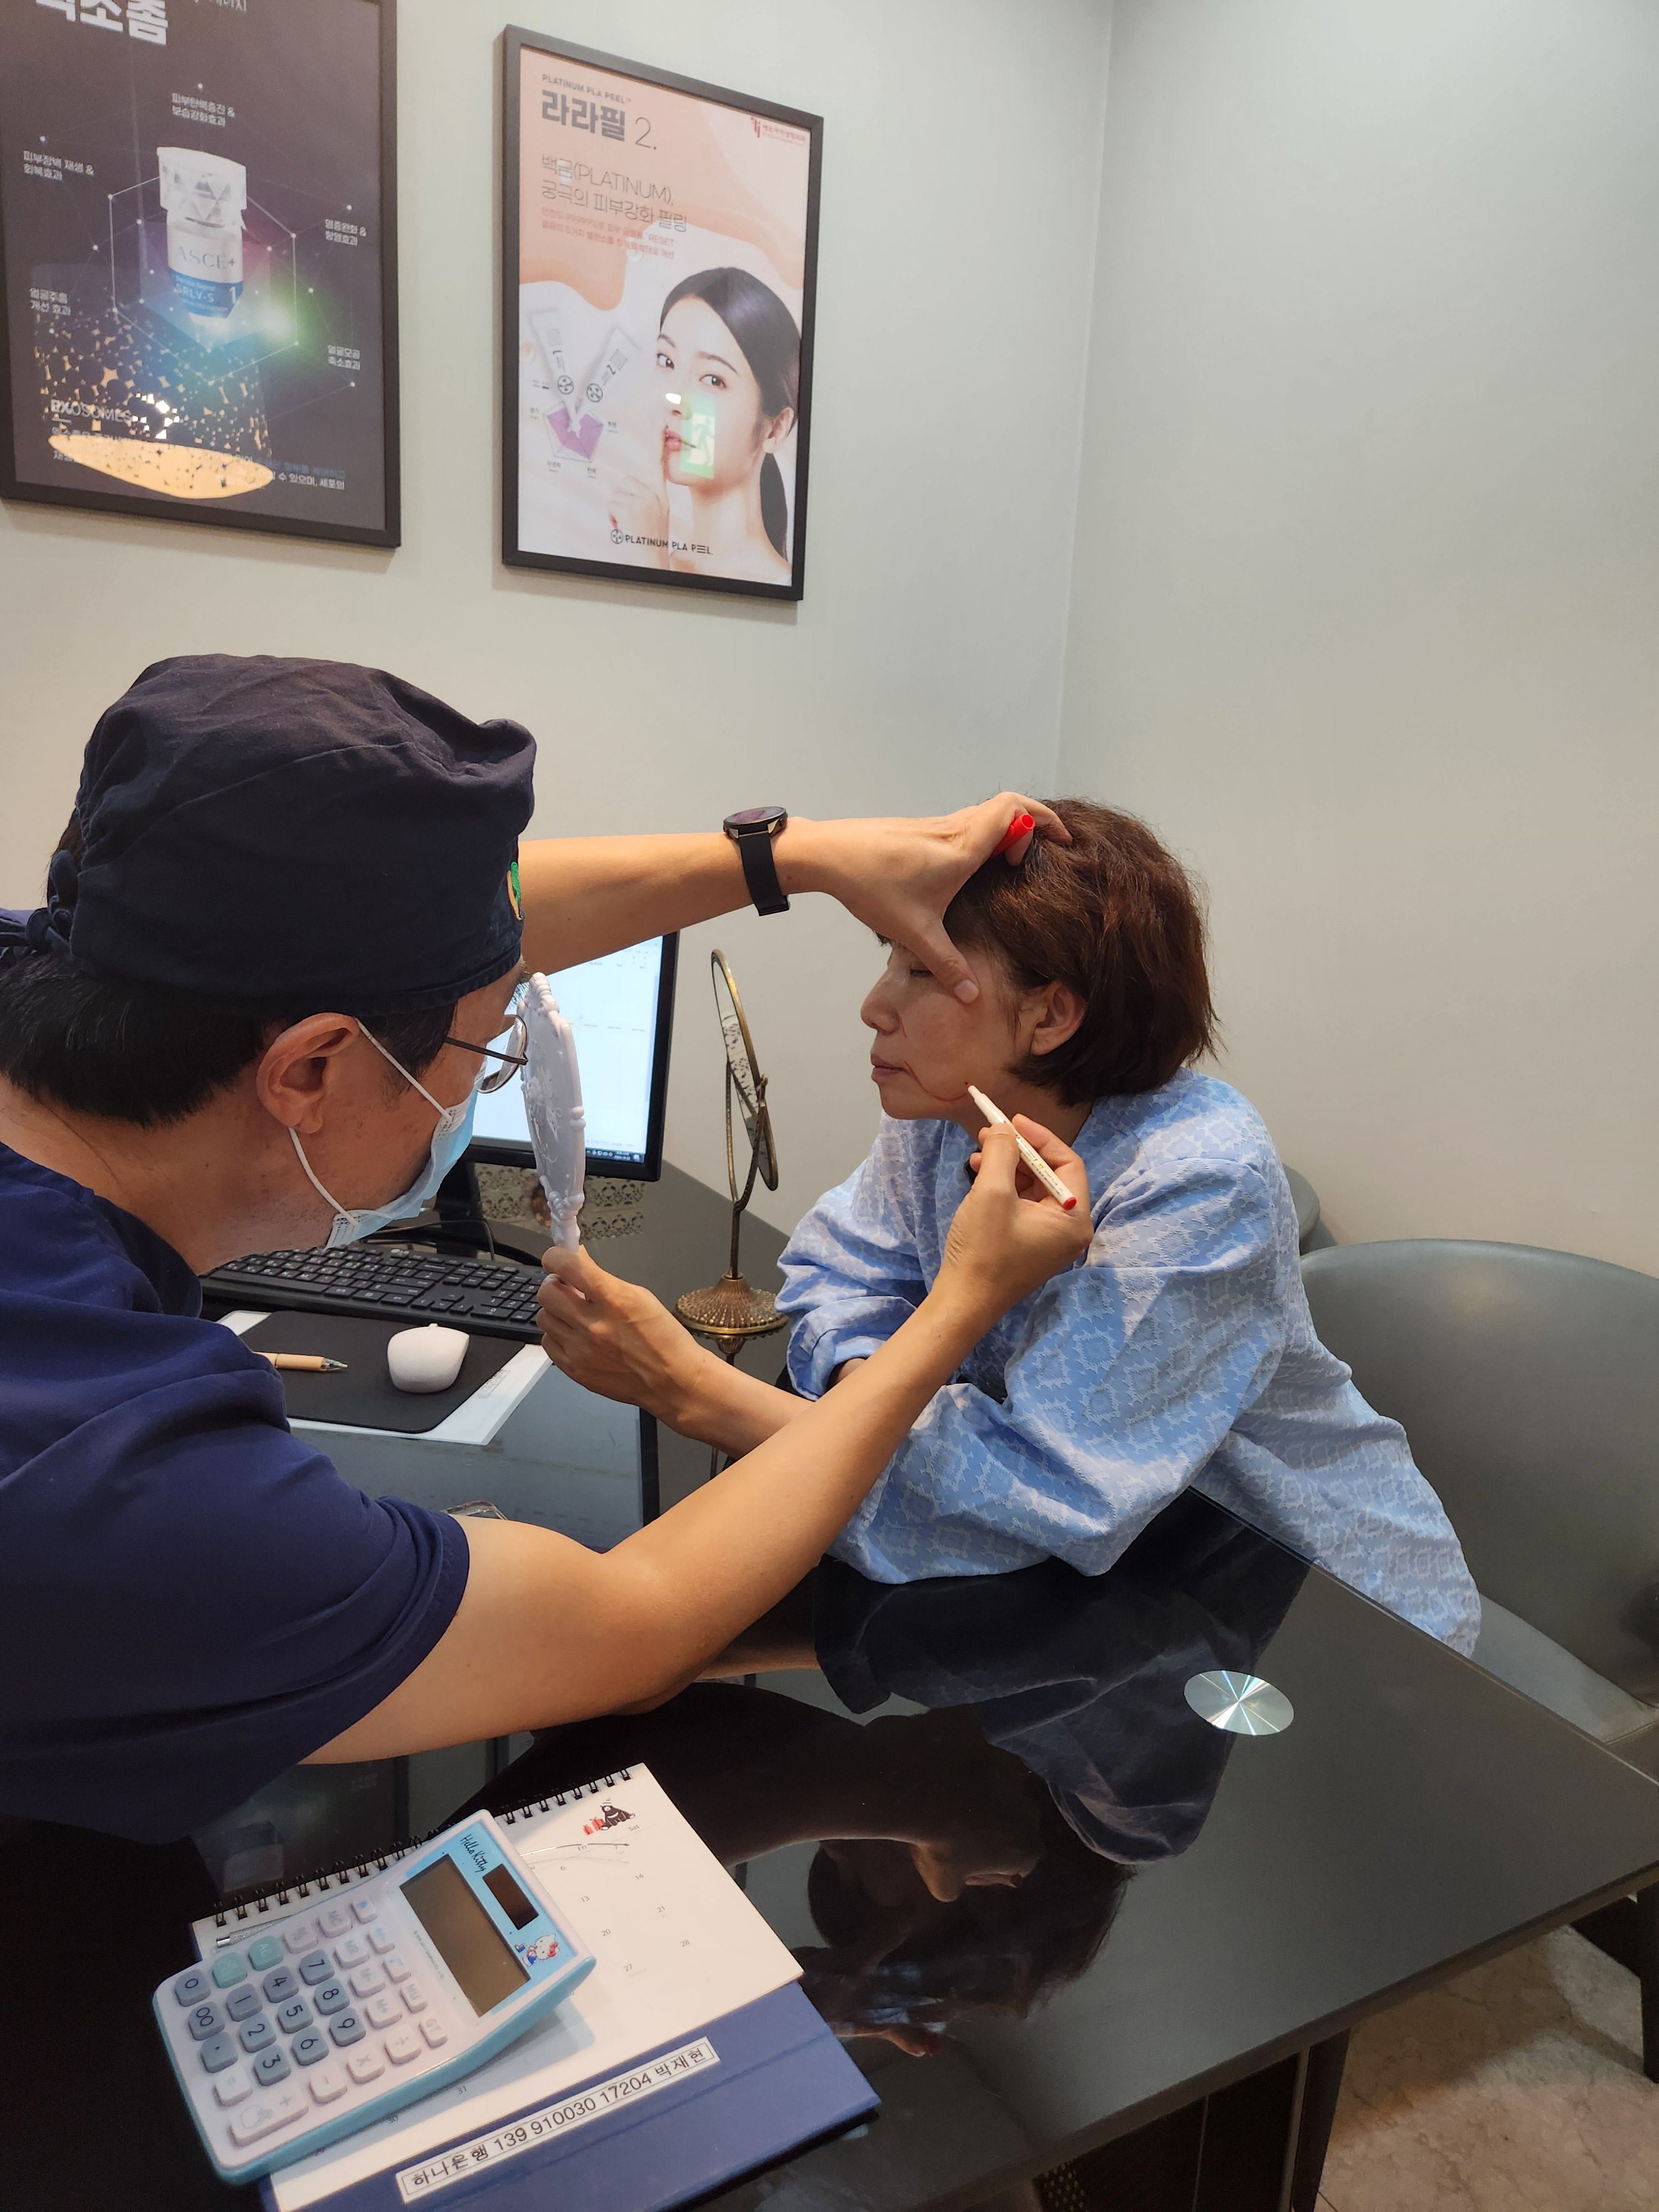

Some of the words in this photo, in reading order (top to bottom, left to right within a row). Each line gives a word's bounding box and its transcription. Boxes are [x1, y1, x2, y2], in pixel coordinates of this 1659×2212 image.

[542, 74, 584, 92] PLATINUM
[587, 86, 602, 97] PLA
[542, 90, 625, 142] 라라필
[541, 179, 588, 208] 궁극의
[594, 193, 654, 224] 피부강화
[659, 210, 687, 233] 필링
[625, 535, 669, 549] PLATINUM
[672, 541, 687, 551] PLA
[628, 1824, 640, 1832] Sat
[460, 1834, 479, 1854] Hello
[471, 1850, 488, 1873] Kitty
[680, 1939, 690, 1947] 28
[257, 1943, 272, 1957] AC
[308, 1959, 325, 1967] 7
[185, 1978, 199, 1989] 0
[273, 1977, 288, 1987] 4
[235, 1995, 252, 2004] 1
[322, 1987, 340, 2000] 8
[196, 2007, 214, 2027] 00
[286, 2004, 304, 2017] 5
[248, 2023, 265, 2037] 2
[337, 2018, 355, 2029] 9
[300, 2038, 319, 2049] 6
[263, 2054, 281, 2069] 3
[457, 2085, 467, 2095] 31
[494, 2127, 528, 2150] 139
[530, 2098, 596, 2135] 910030
[600, 2072, 651, 2103] 17204
[654, 2048, 706, 2077] 박재현
[388, 2115, 399, 2124] 30
